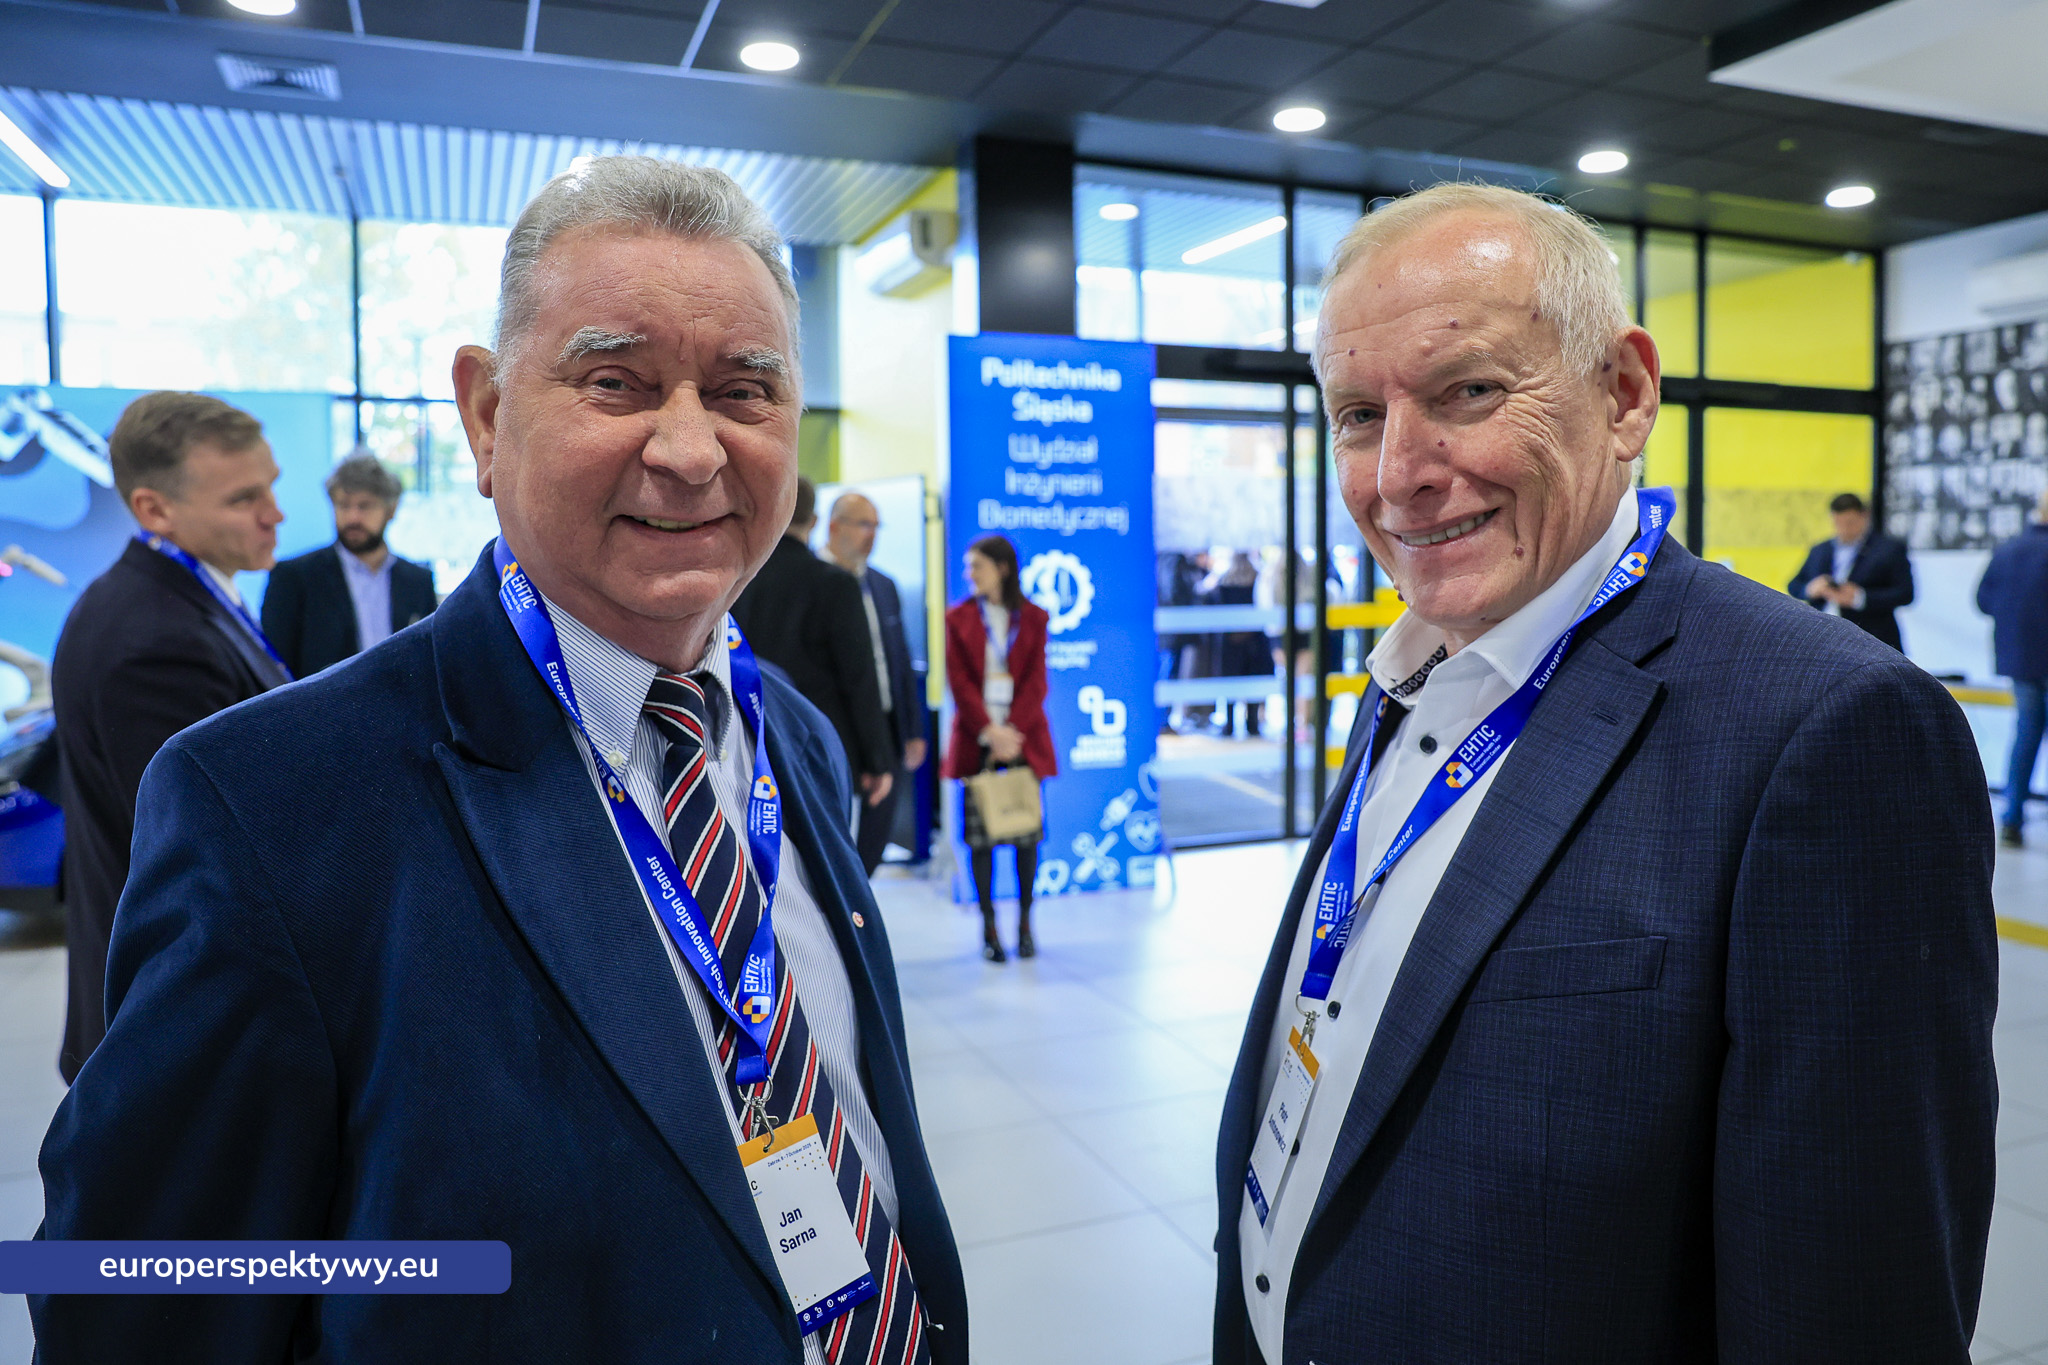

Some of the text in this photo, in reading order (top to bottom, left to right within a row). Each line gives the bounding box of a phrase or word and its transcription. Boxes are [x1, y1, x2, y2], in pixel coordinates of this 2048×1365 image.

[1649, 504, 1663, 530] enter
[510, 573, 538, 609] EHTIC
[1593, 571, 1632, 607] EHTIC
[1533, 631, 1572, 690] European
[1458, 724, 1496, 763] EHTIC
[762, 802, 777, 834] EHTIC
[1387, 824, 1413, 860] Center
[646, 855, 675, 899] Center
[1318, 881, 1338, 921] EHTIC
[670, 896, 714, 966] Innovation
[743, 953, 760, 993] EHTIC
[779, 1207, 803, 1228] Jan
[779, 1227, 817, 1254] Sarna
